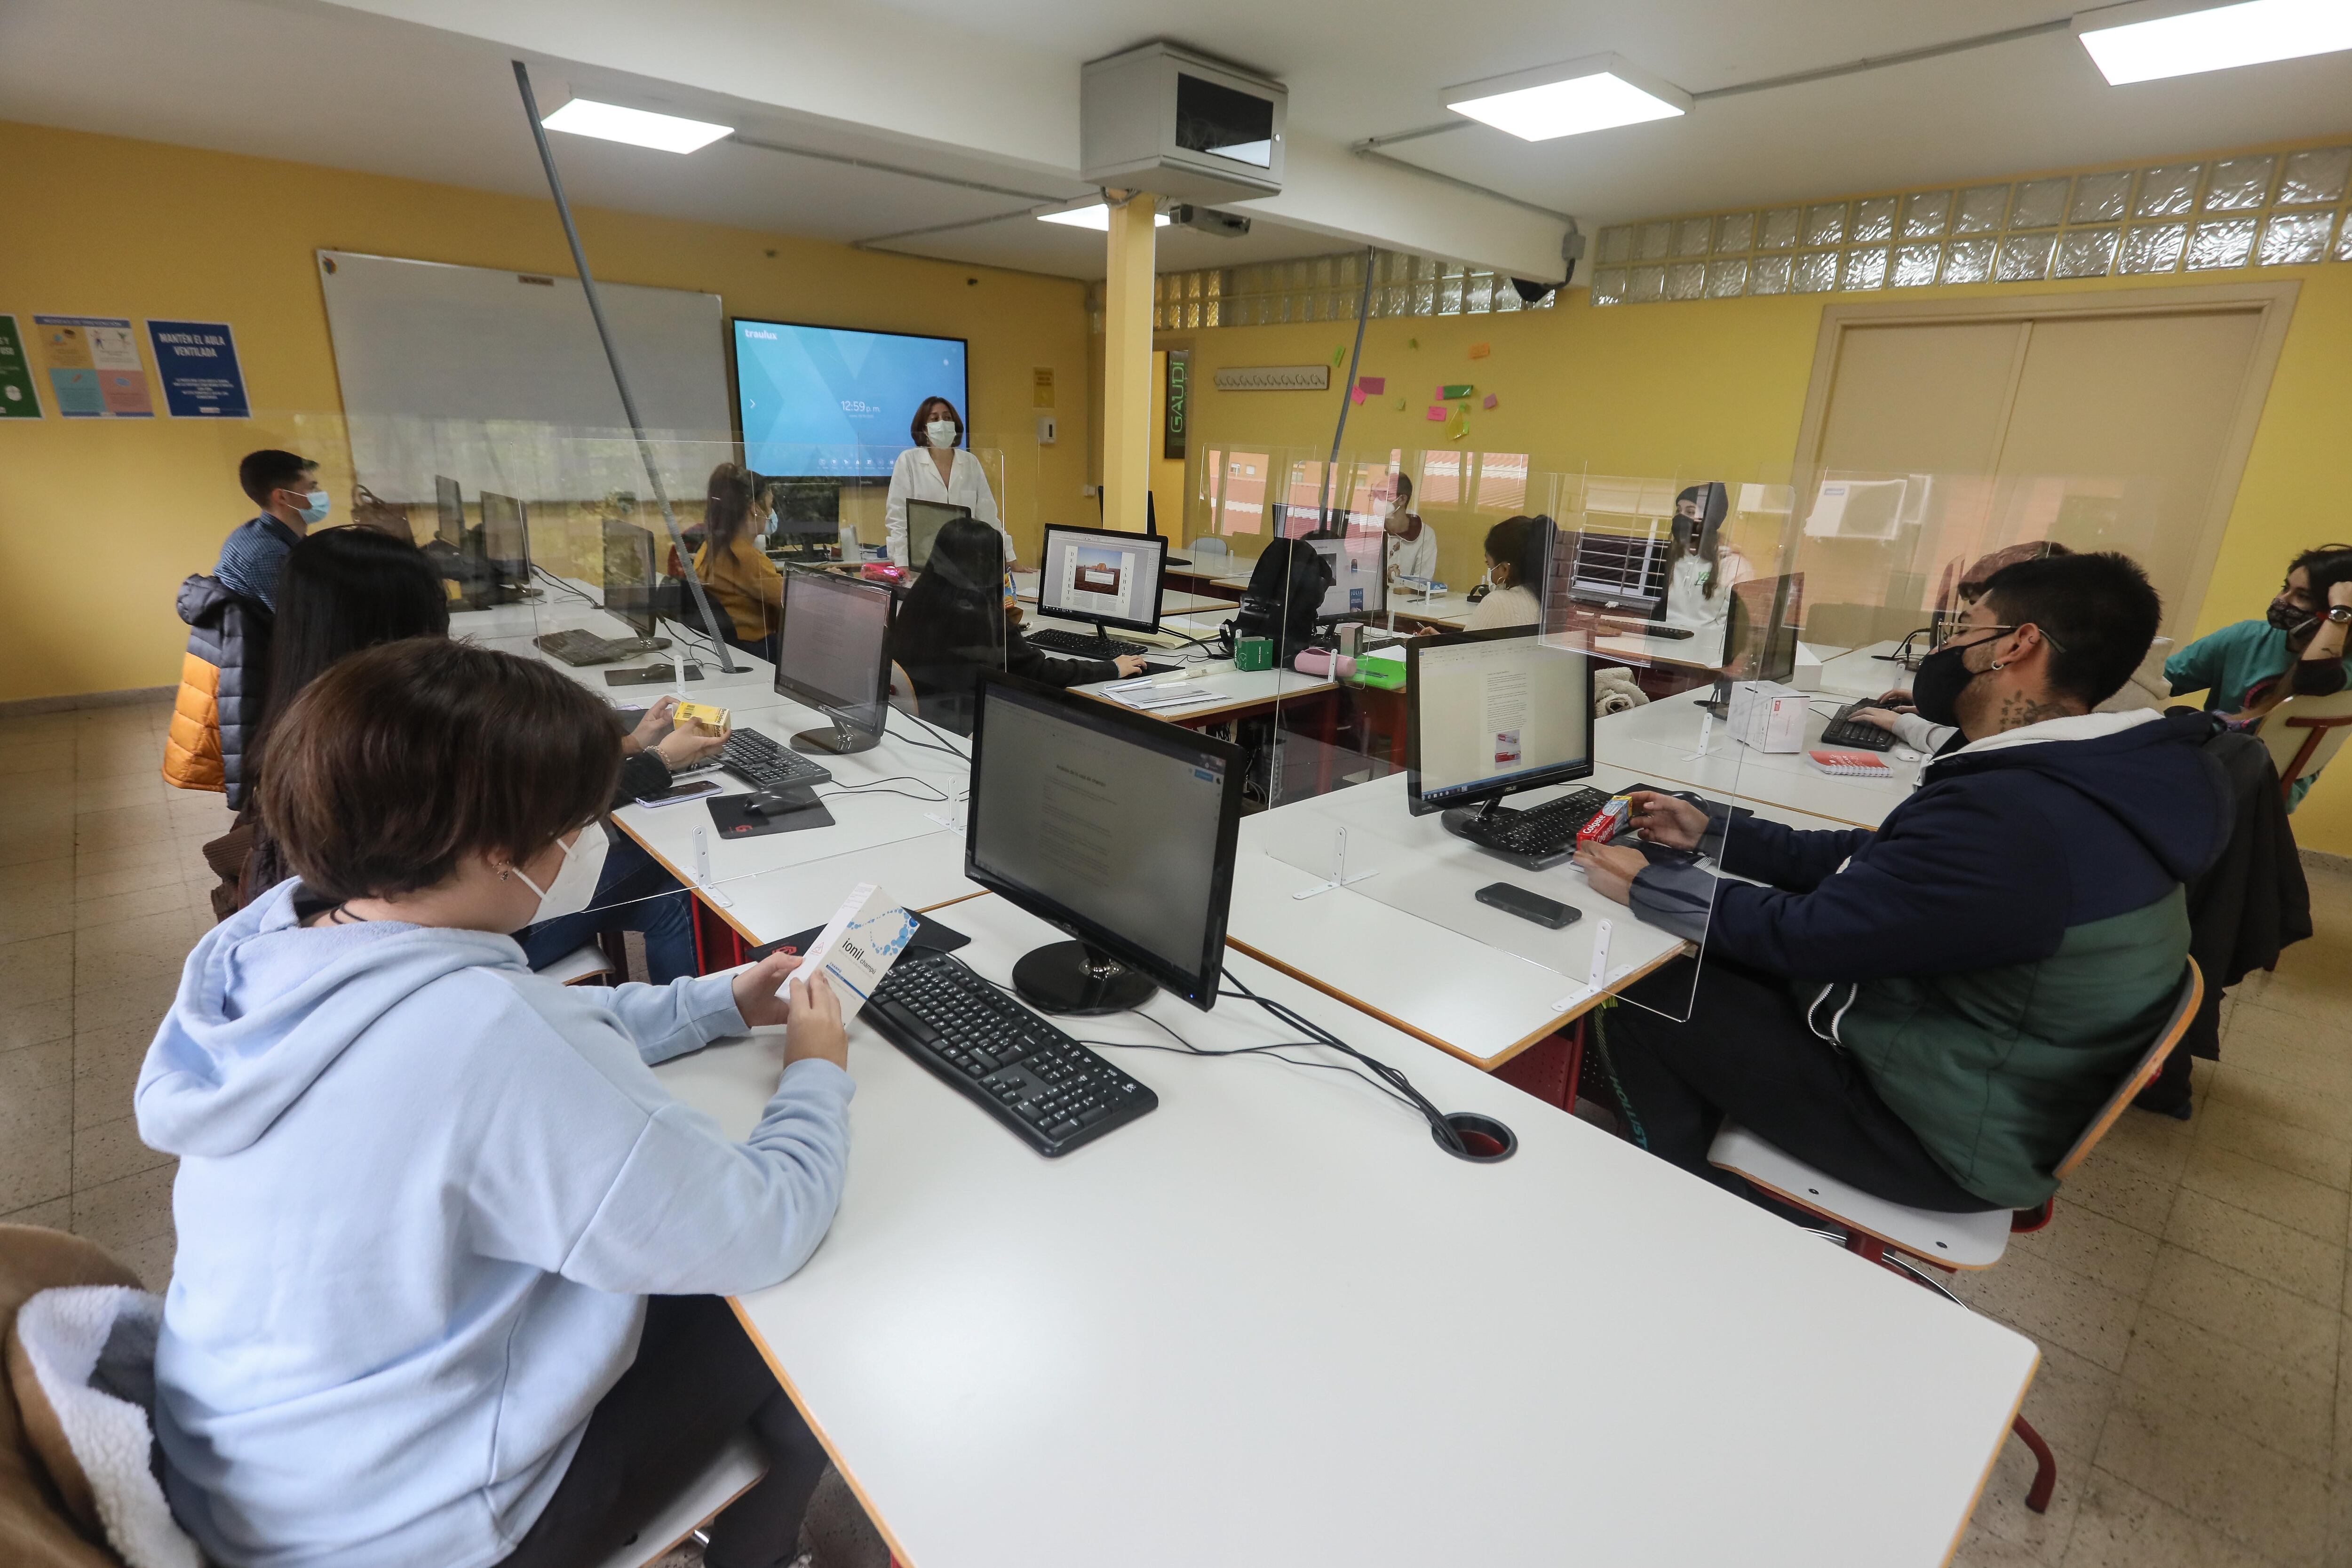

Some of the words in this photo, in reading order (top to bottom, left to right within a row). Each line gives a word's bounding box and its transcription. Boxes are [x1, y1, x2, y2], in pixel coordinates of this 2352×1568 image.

[192, 334, 204, 344] EL
[204, 335, 226, 346] AULA
[745, 329, 777, 340] traulux
[173, 346, 218, 357] VENTILADA
[841, 400, 865, 411] 12:59
[1583, 814, 1606, 834] Colgate
[842, 938, 864, 961] ionil
[859, 959, 876, 975] champú
